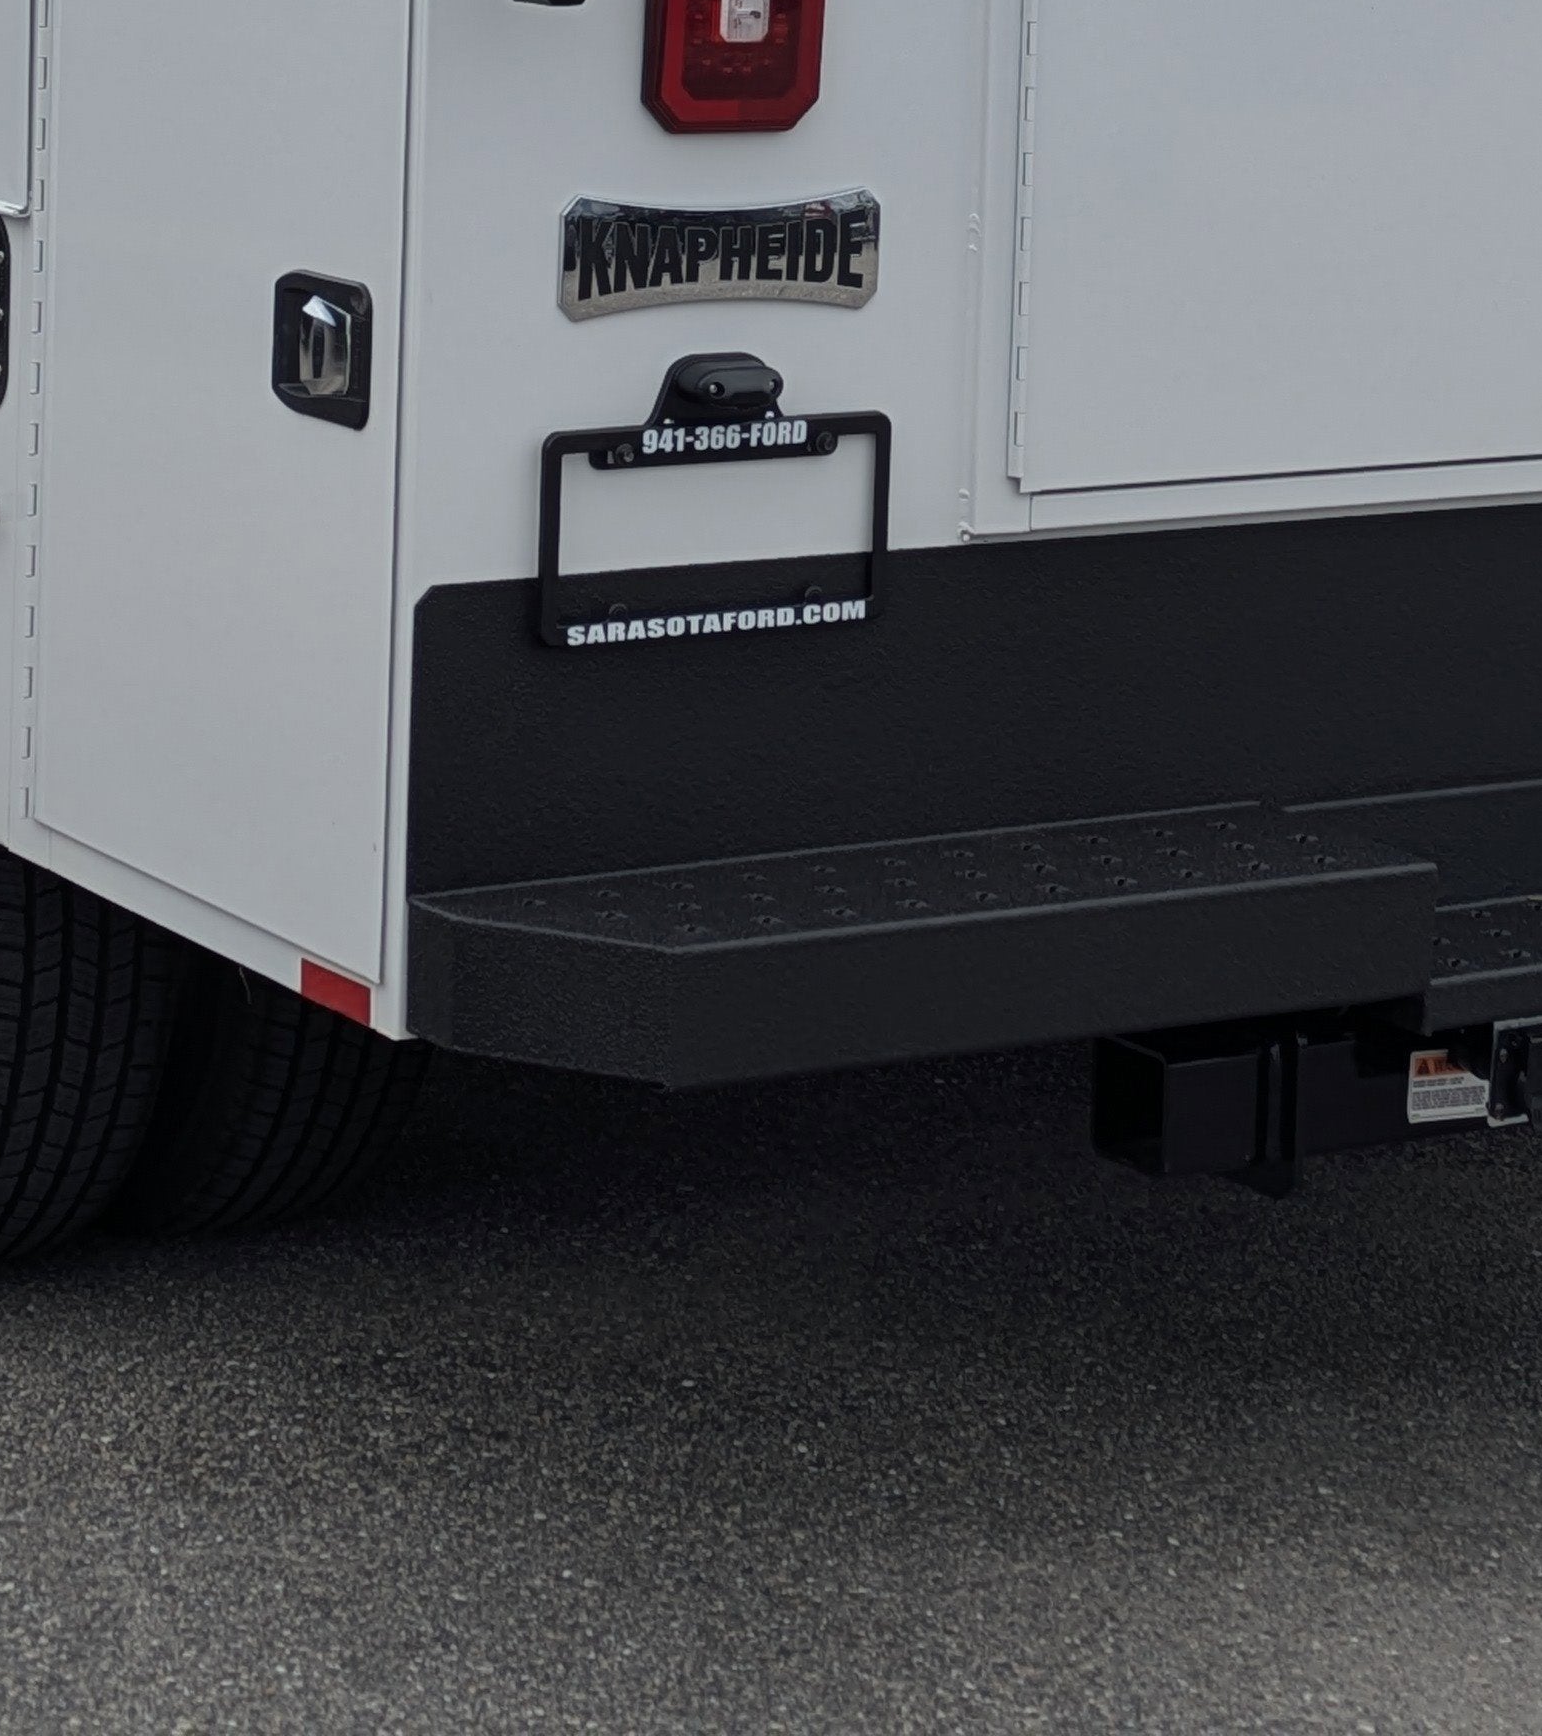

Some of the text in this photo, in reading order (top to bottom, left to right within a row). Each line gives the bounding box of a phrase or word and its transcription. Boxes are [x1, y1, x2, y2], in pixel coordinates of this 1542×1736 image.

[576, 211, 865, 302] KNAPHEIDE
[642, 419, 808, 454] 941-366-FORD
[566, 599, 866, 646] SARASOTAFORD.COM
